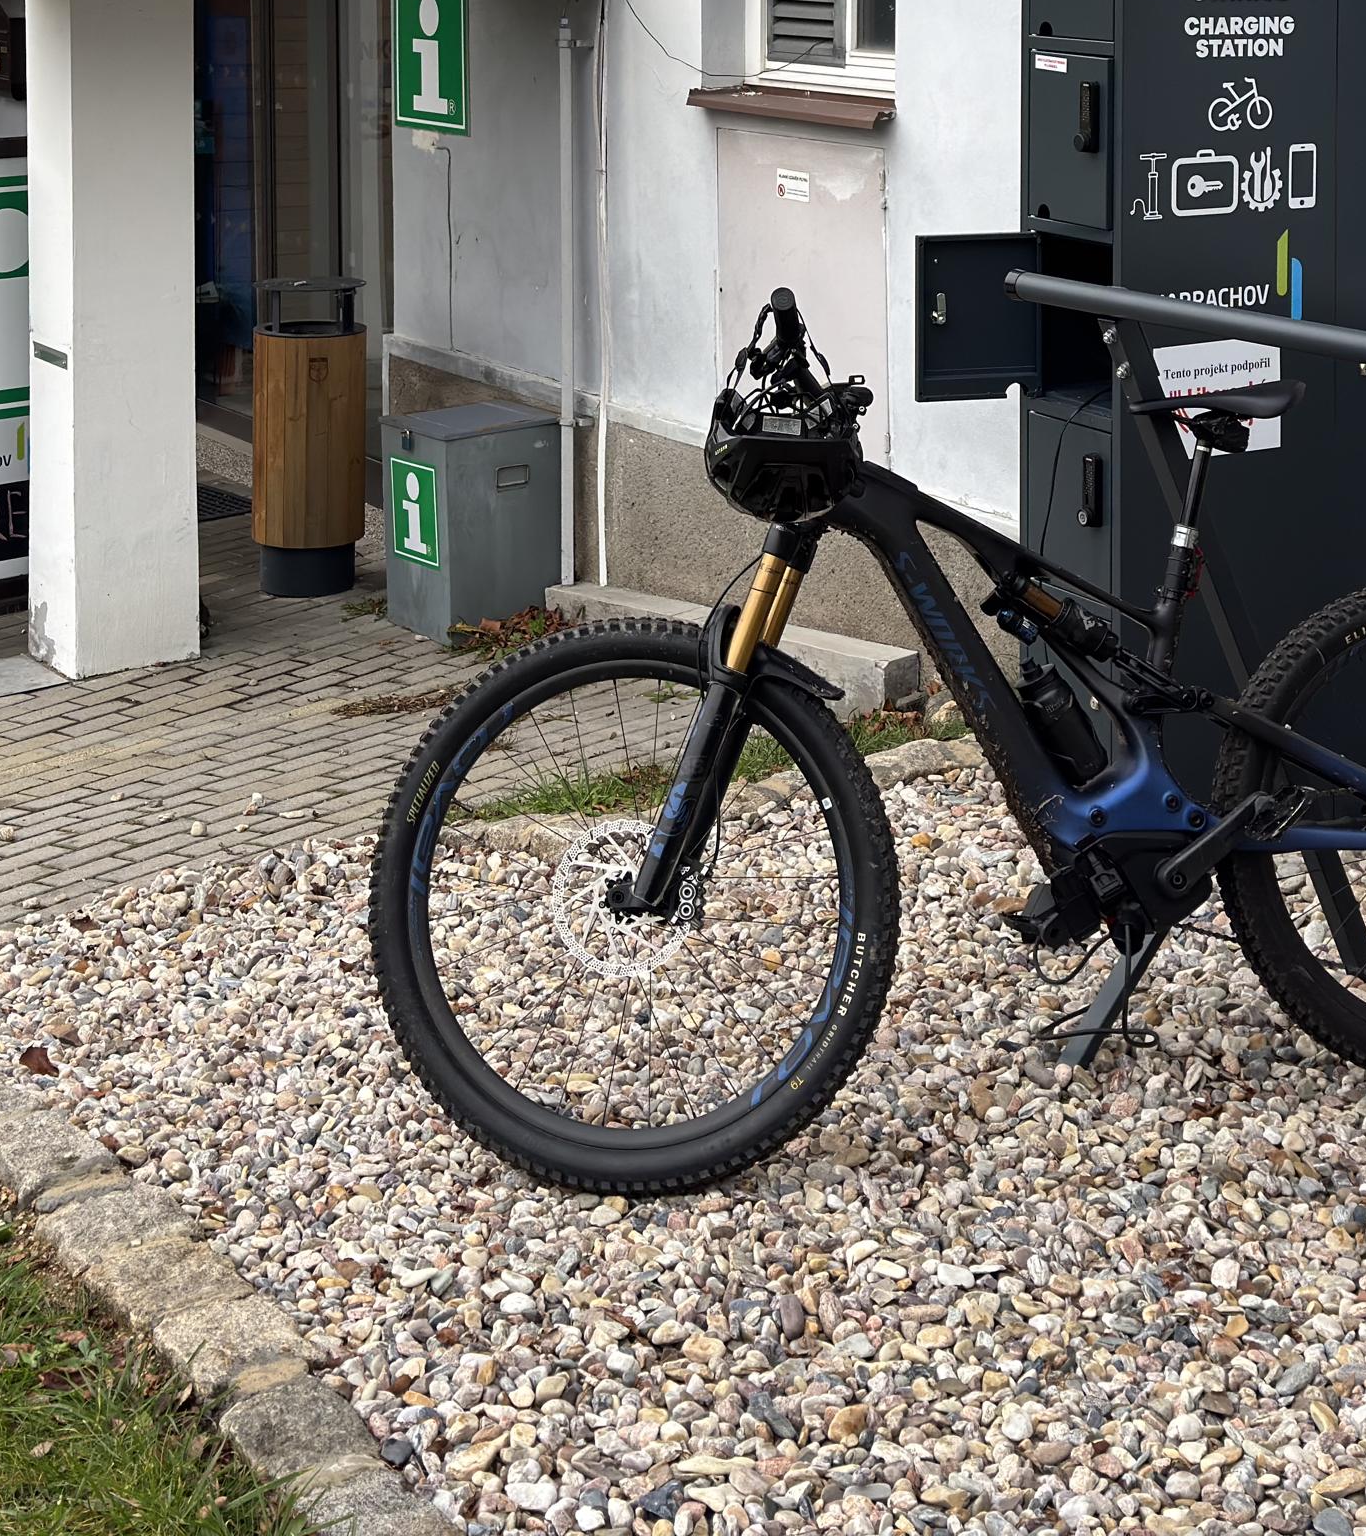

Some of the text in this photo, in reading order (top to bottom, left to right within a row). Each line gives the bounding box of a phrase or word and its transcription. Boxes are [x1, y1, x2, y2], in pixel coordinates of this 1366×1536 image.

[1184, 15, 1295, 36] CHARGING
[1195, 38, 1284, 58] STATION
[1163, 357, 1271, 380] Tento projekt podpořil
[406, 760, 439, 826] SPECIALIZED
[837, 932, 866, 1015] BUTCHER
